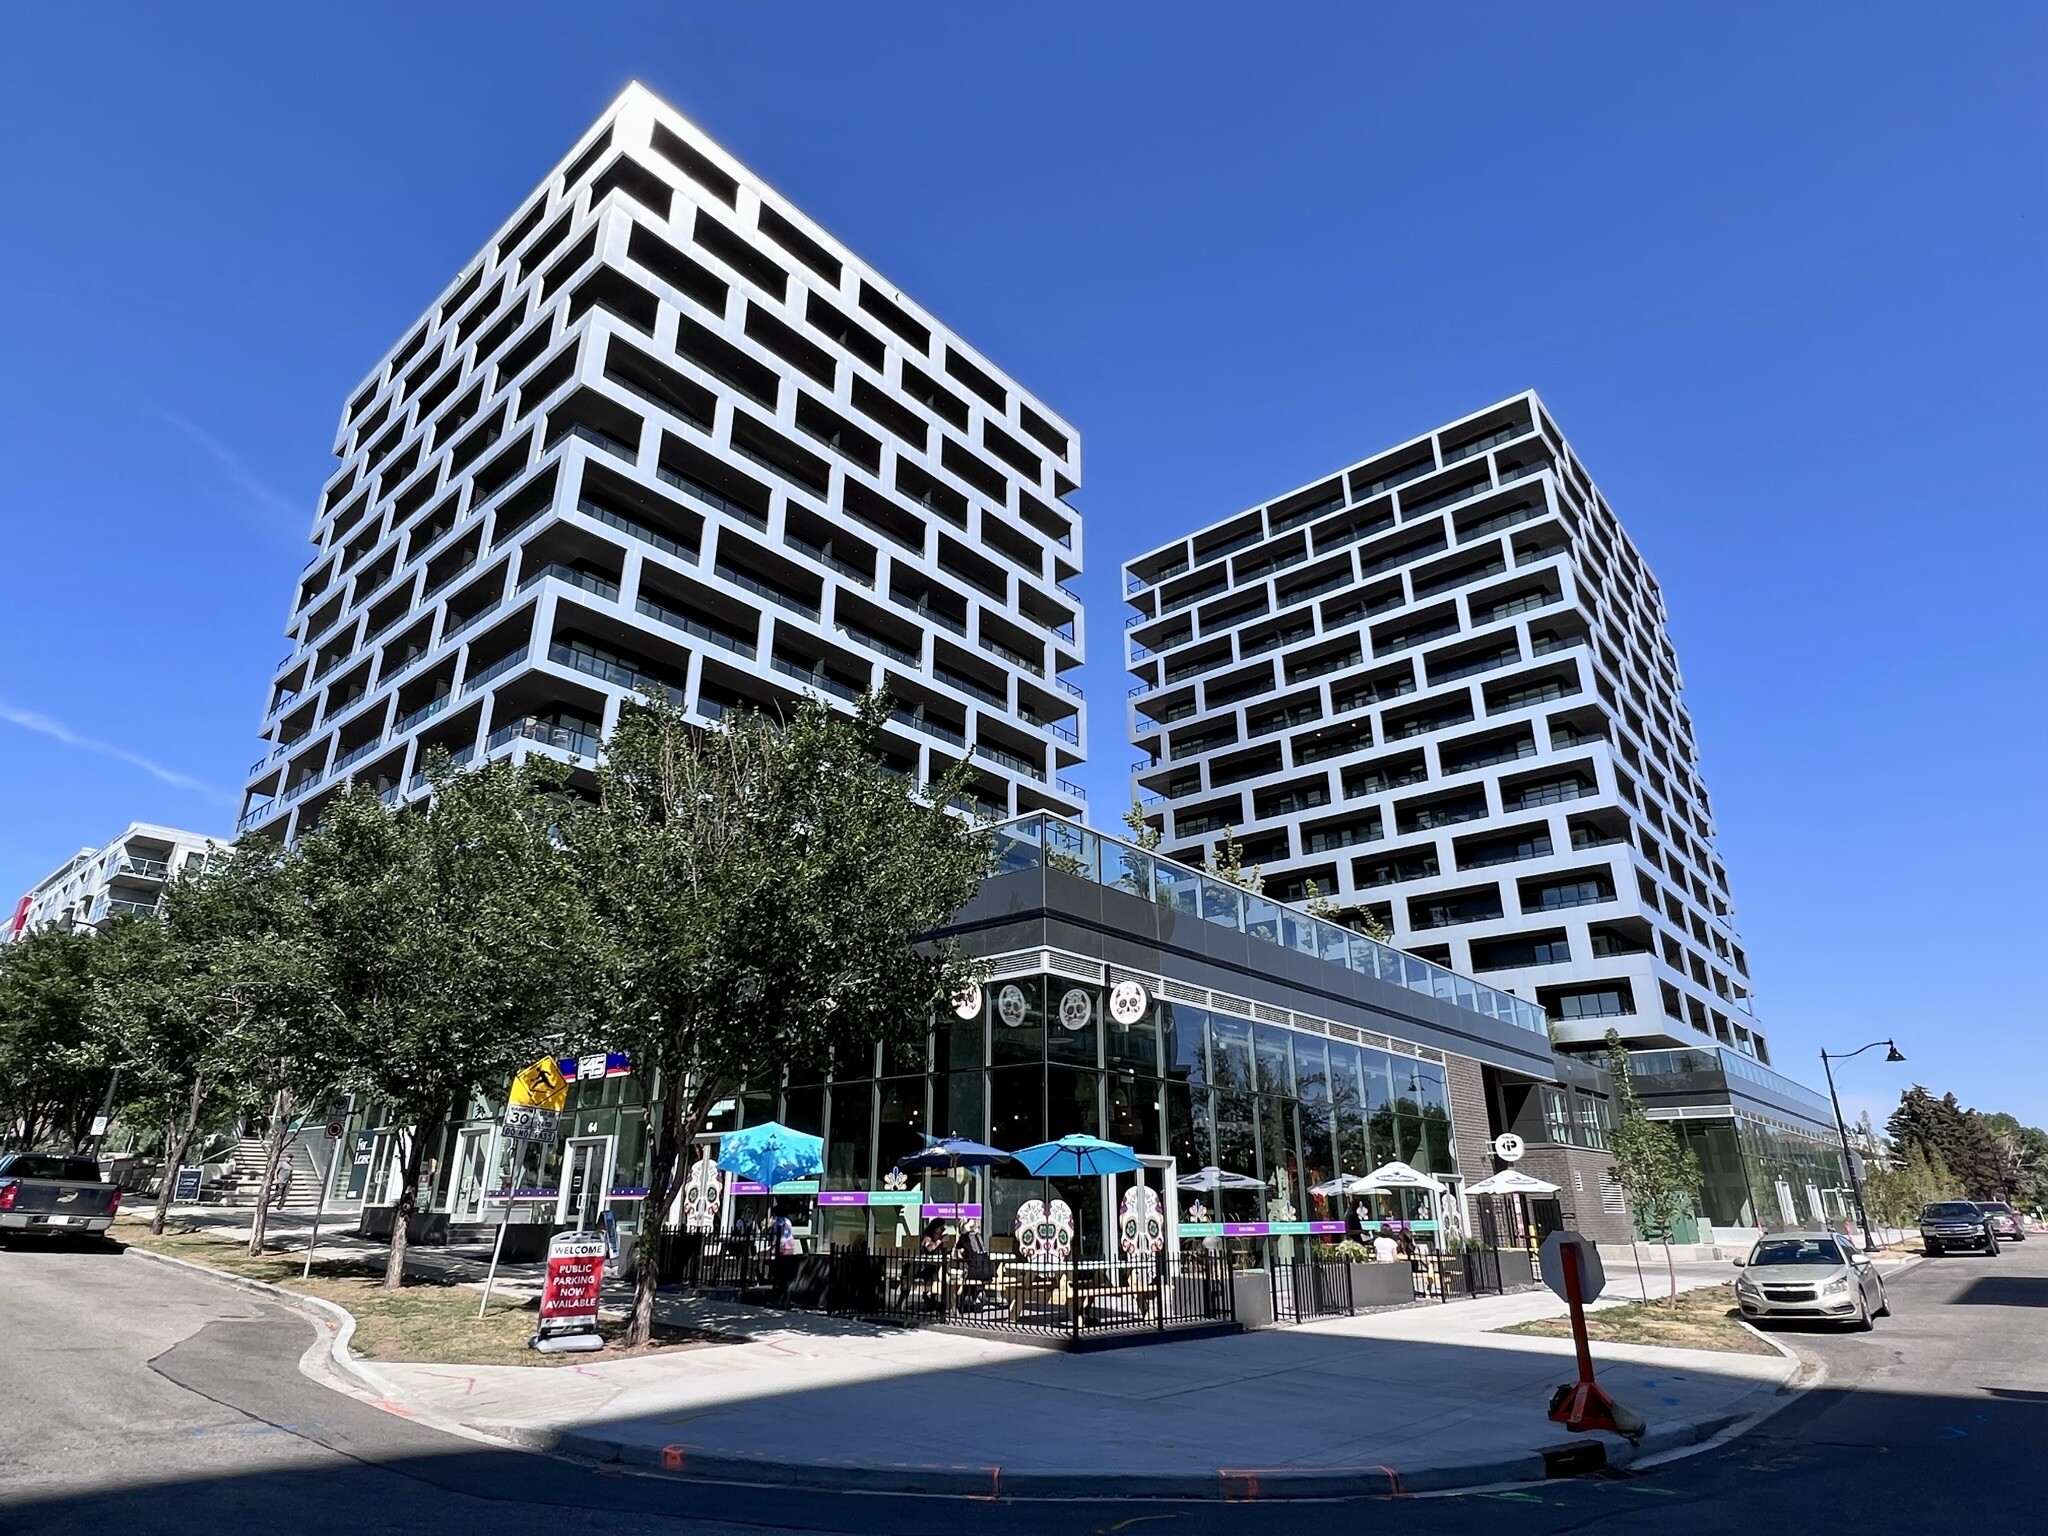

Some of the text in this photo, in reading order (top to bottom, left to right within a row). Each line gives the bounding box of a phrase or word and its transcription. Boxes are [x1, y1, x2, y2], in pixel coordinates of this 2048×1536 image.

[510, 1112, 529, 1125] 30
[505, 1127, 516, 1136] DO
[518, 1129, 533, 1138] NOT
[554, 1245, 603, 1255] WELCOME
[559, 1264, 593, 1274] PUBLIC
[552, 1275, 596, 1286] PARKING
[560, 1287, 586, 1297] NOW
[545, 1298, 597, 1309] AVAILABLE
